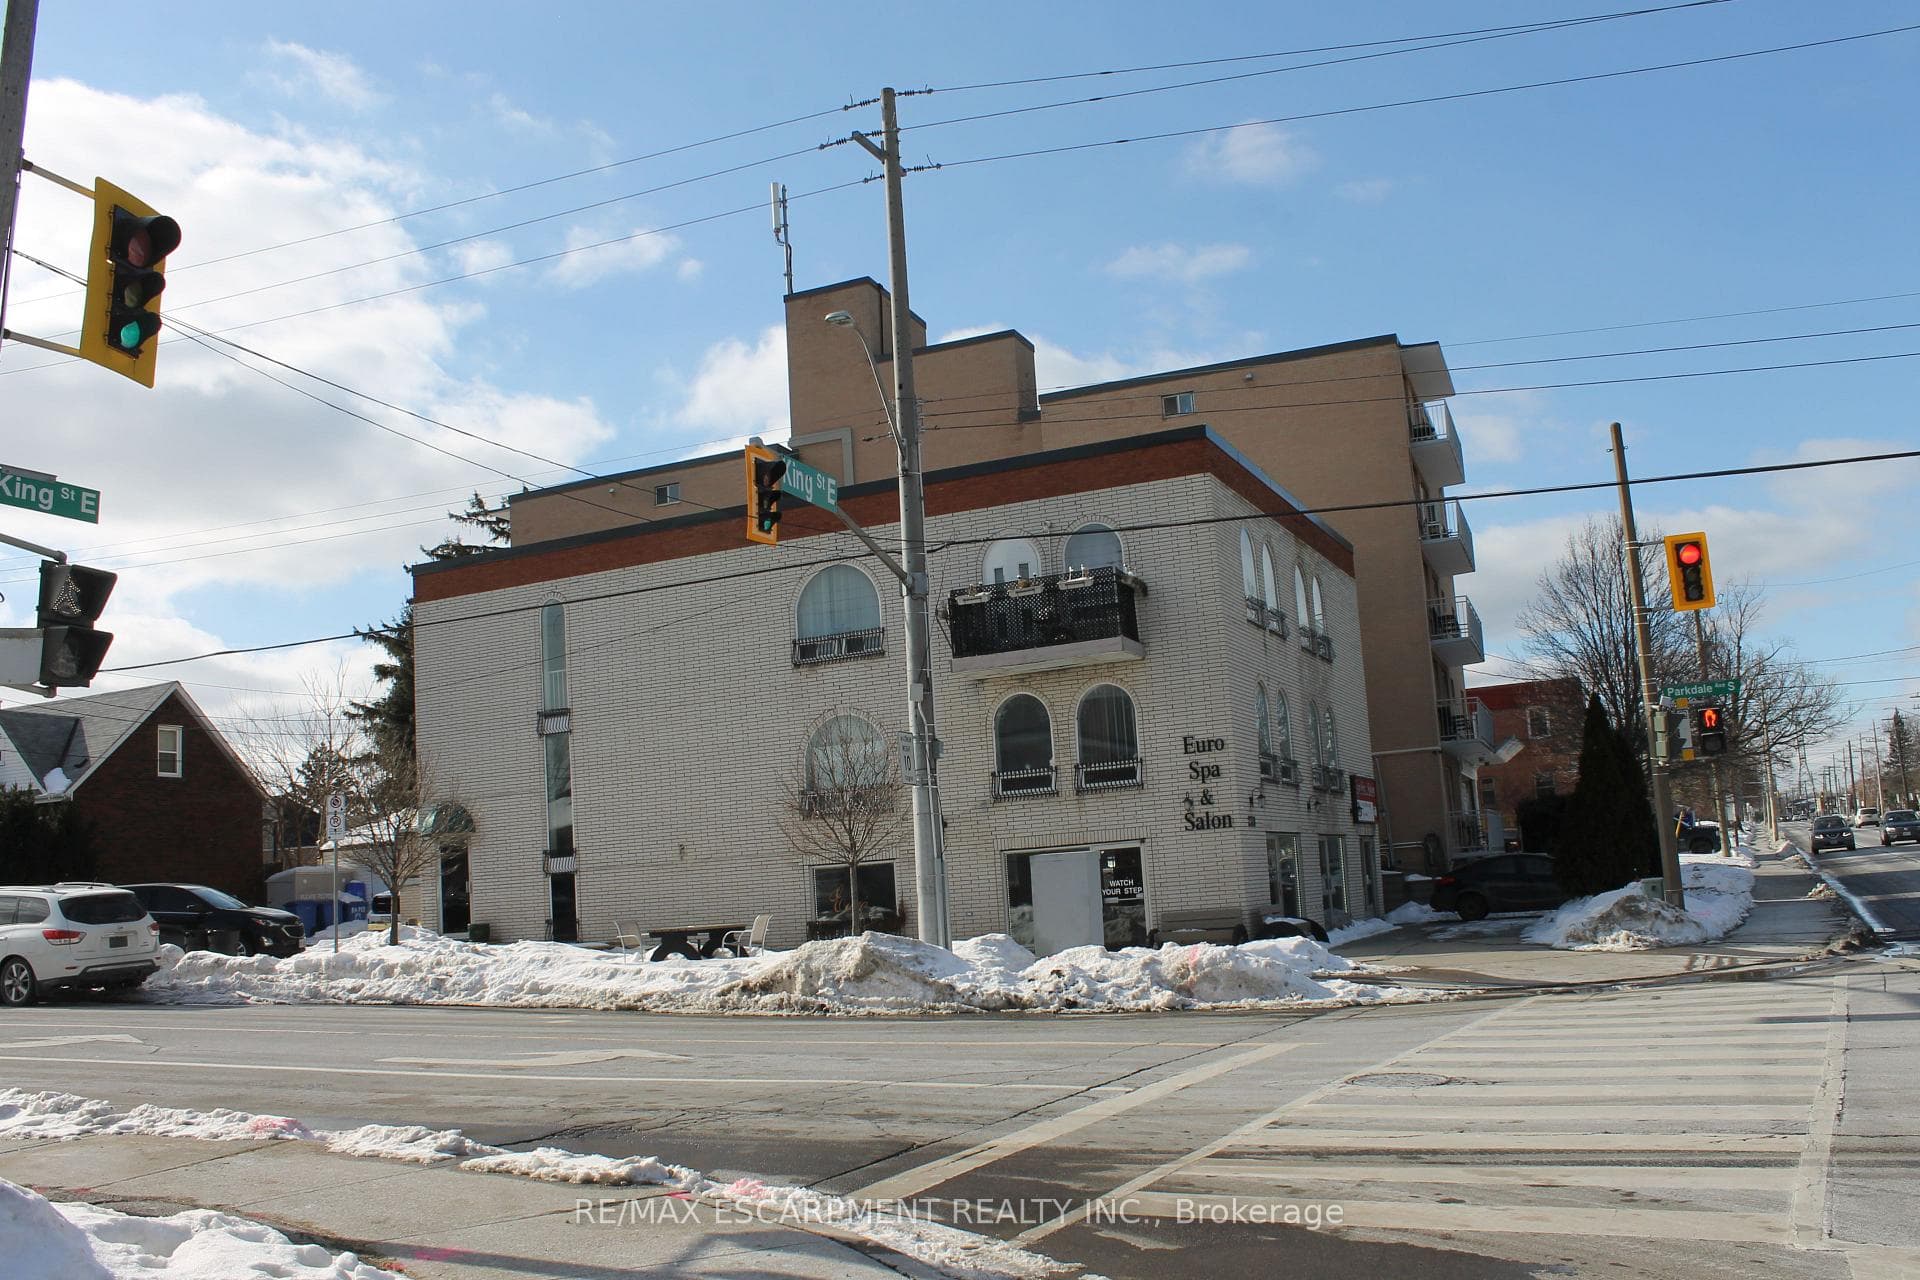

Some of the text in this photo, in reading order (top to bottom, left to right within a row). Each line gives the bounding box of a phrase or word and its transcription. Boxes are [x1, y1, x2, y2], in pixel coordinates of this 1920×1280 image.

[783, 457, 836, 505] King St E
[0, 474, 97, 515] King St E
[1667, 684, 1713, 696] Parkdale
[1727, 681, 1735, 691] S
[1183, 736, 1225, 755] Euro
[1189, 761, 1221, 784] Spa
[1200, 788, 1215, 806] &
[1184, 811, 1233, 832] Salon
[1102, 886, 1143, 896] YOUR STEP
[1109, 879, 1134, 887] WATCH
